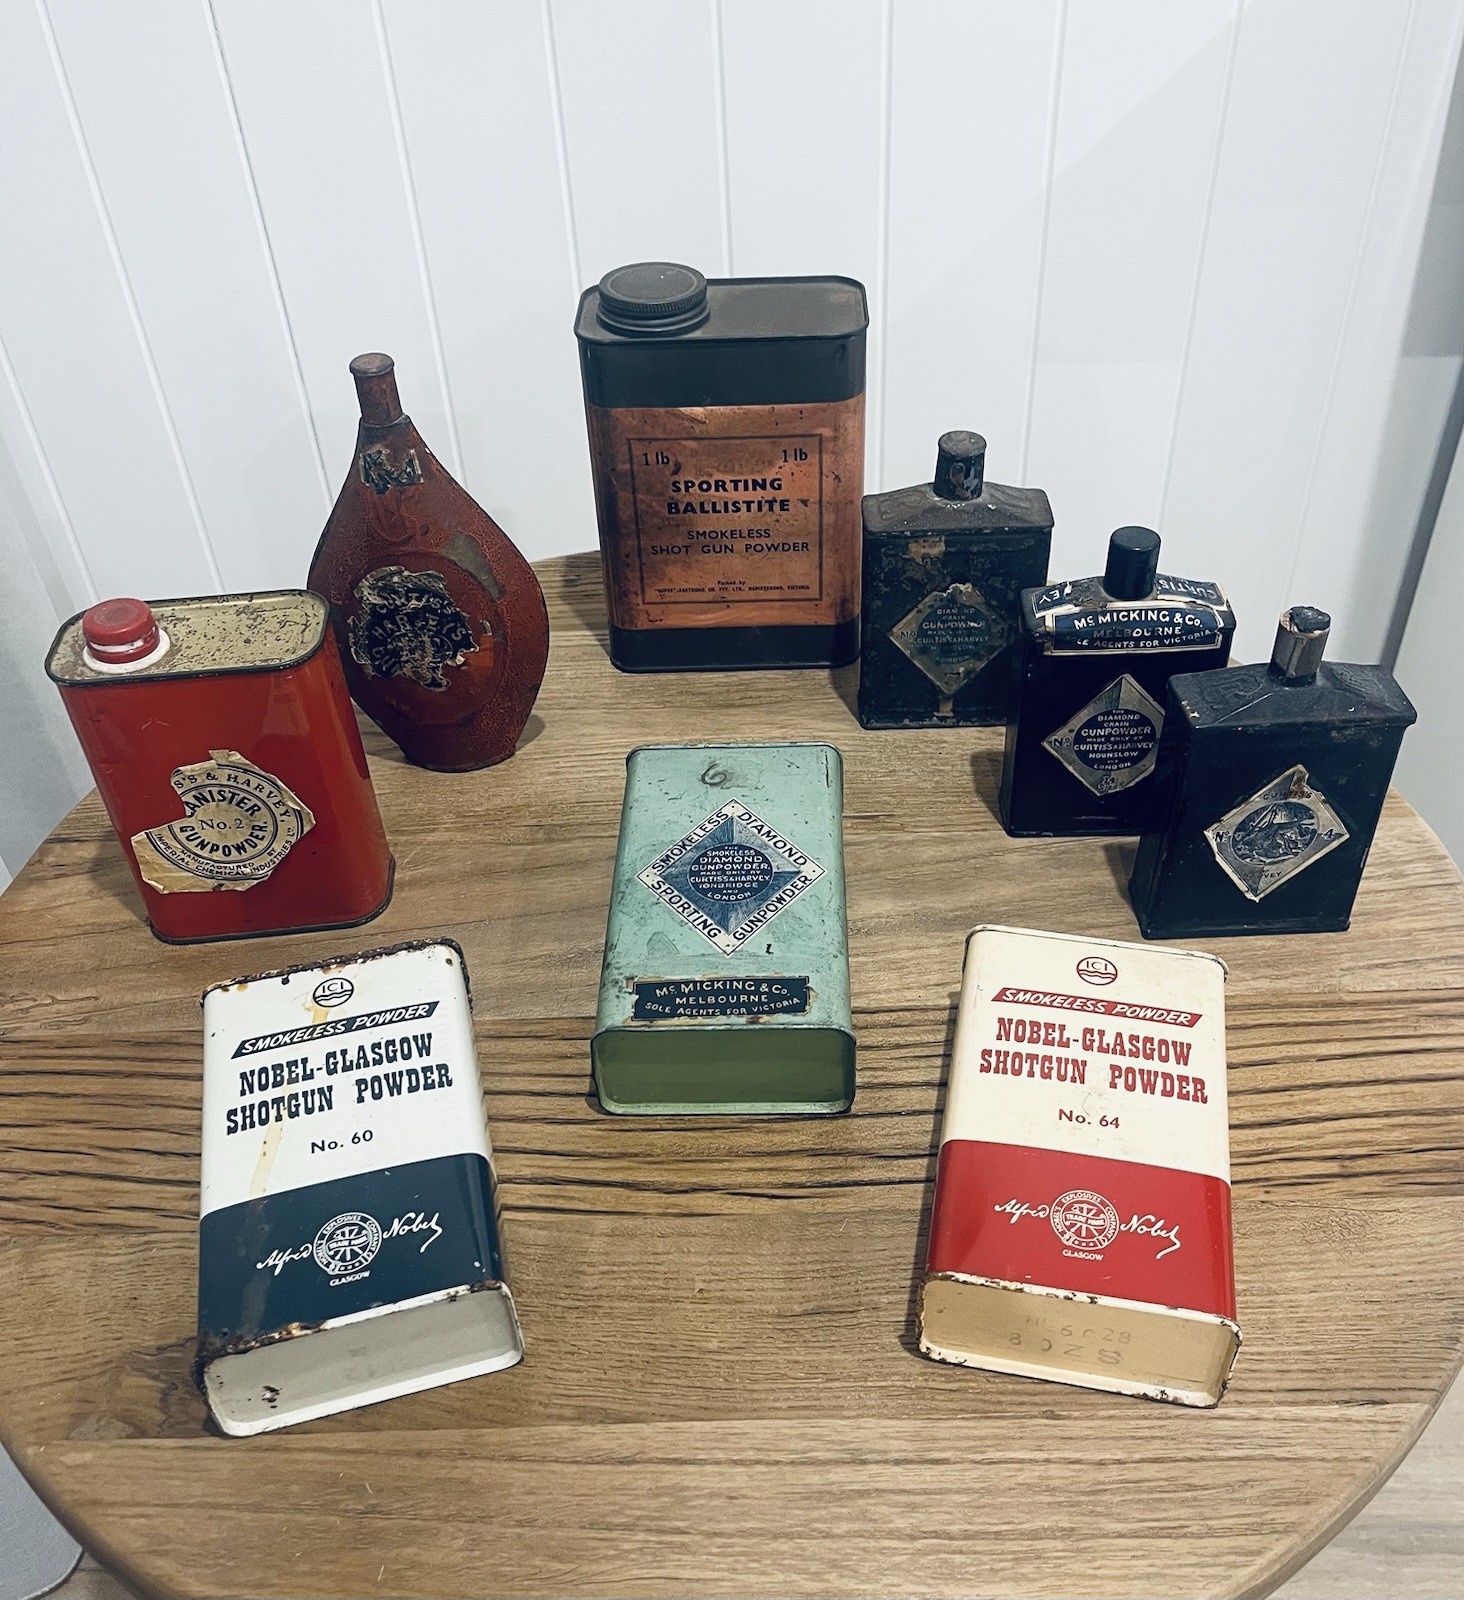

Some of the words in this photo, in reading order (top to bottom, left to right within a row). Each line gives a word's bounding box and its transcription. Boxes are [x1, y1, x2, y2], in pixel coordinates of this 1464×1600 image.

[642, 452, 650, 466] 1
[655, 451, 670, 466] lb
[782, 449, 790, 463] 1
[793, 448, 808, 462] lb
[671, 478, 783, 494] SPORTING
[666, 498, 790, 515] BALLISTITE
[687, 528, 771, 540] SMOKELESS
[651, 545, 692, 556] SHOT
[701, 544, 734, 554] GUN
[744, 542, 810, 553] POWDER
[1094, 640, 1135, 648] AGENTS
[1140, 640, 1160, 648] FOR
[1098, 714, 1140, 722] DIAMOND
[1081, 726, 1152, 736] GUNPOWDER
[1088, 751, 1138, 759] HOUNSLOW
[701, 763, 728, 786] 6
[1094, 762, 1132, 770] LONDON
[206, 772, 219, 782] &
[184, 790, 262, 818] ANISTER
[651, 811, 729, 874] SMOKELESS
[738, 811, 808, 868] DIAMOND
[1322, 828, 1334, 840] 4
[154, 833, 191, 866] IMPERIAL
[195, 864, 250, 876] CHEMICAL
[250, 840, 293, 874] INDUSTRIES
[180, 850, 256, 871] MANUFACTURED
[266, 847, 276, 858] BY
[700, 856, 763, 864] DIAMOND
[651, 880, 722, 940] SPORTING
[732, 874, 812, 942] GUNPOWDER
[1086, 960, 1109, 972] ICI
[322, 982, 344, 994] ICI
[645, 1002, 671, 1014] SOLE
[676, 1008, 720, 1016] AGENTS
[726, 1008, 748, 1016] FOR
[752, 997, 800, 1013] VICTORIA
[676, 994, 769, 1005] MELBOURNE
[1002, 988, 1108, 1014] SMOKELESS
[1112, 1004, 1193, 1026] POWDER
[241, 1018, 346, 1054] SMOKELESS
[352, 1004, 430, 1030] POWDER
[996, 1018, 1192, 1067] NOBEL-GLASGOW
[239, 1032, 432, 1098] NOBEL-GLASGOW
[980, 1048, 1087, 1085] SHOTGUN
[1109, 1064, 1208, 1104] POWDER
[226, 1084, 334, 1136] SHOTGUN
[355, 1062, 453, 1104] POWDER
[1058, 1108, 1092, 1126] No.
[1100, 1115, 1120, 1129] 64
[310, 1140, 344, 1154] No.
[351, 1130, 374, 1146] 60
[322, 1214, 362, 1235] EXPLOSIVES
[1061, 1192, 1102, 1204] EXPLOSIVES
[1105, 1206, 1118, 1240] COMPANY
[994, 1199, 1050, 1224] Alfred
[1120, 1214, 1181, 1260] Nobel
[256, 1242, 312, 1276] Alfred
[383, 1212, 443, 1254] Nobel
[1062, 1248, 1104, 1262] GLASGOW
[329, 1270, 371, 1287] GLASGOW
